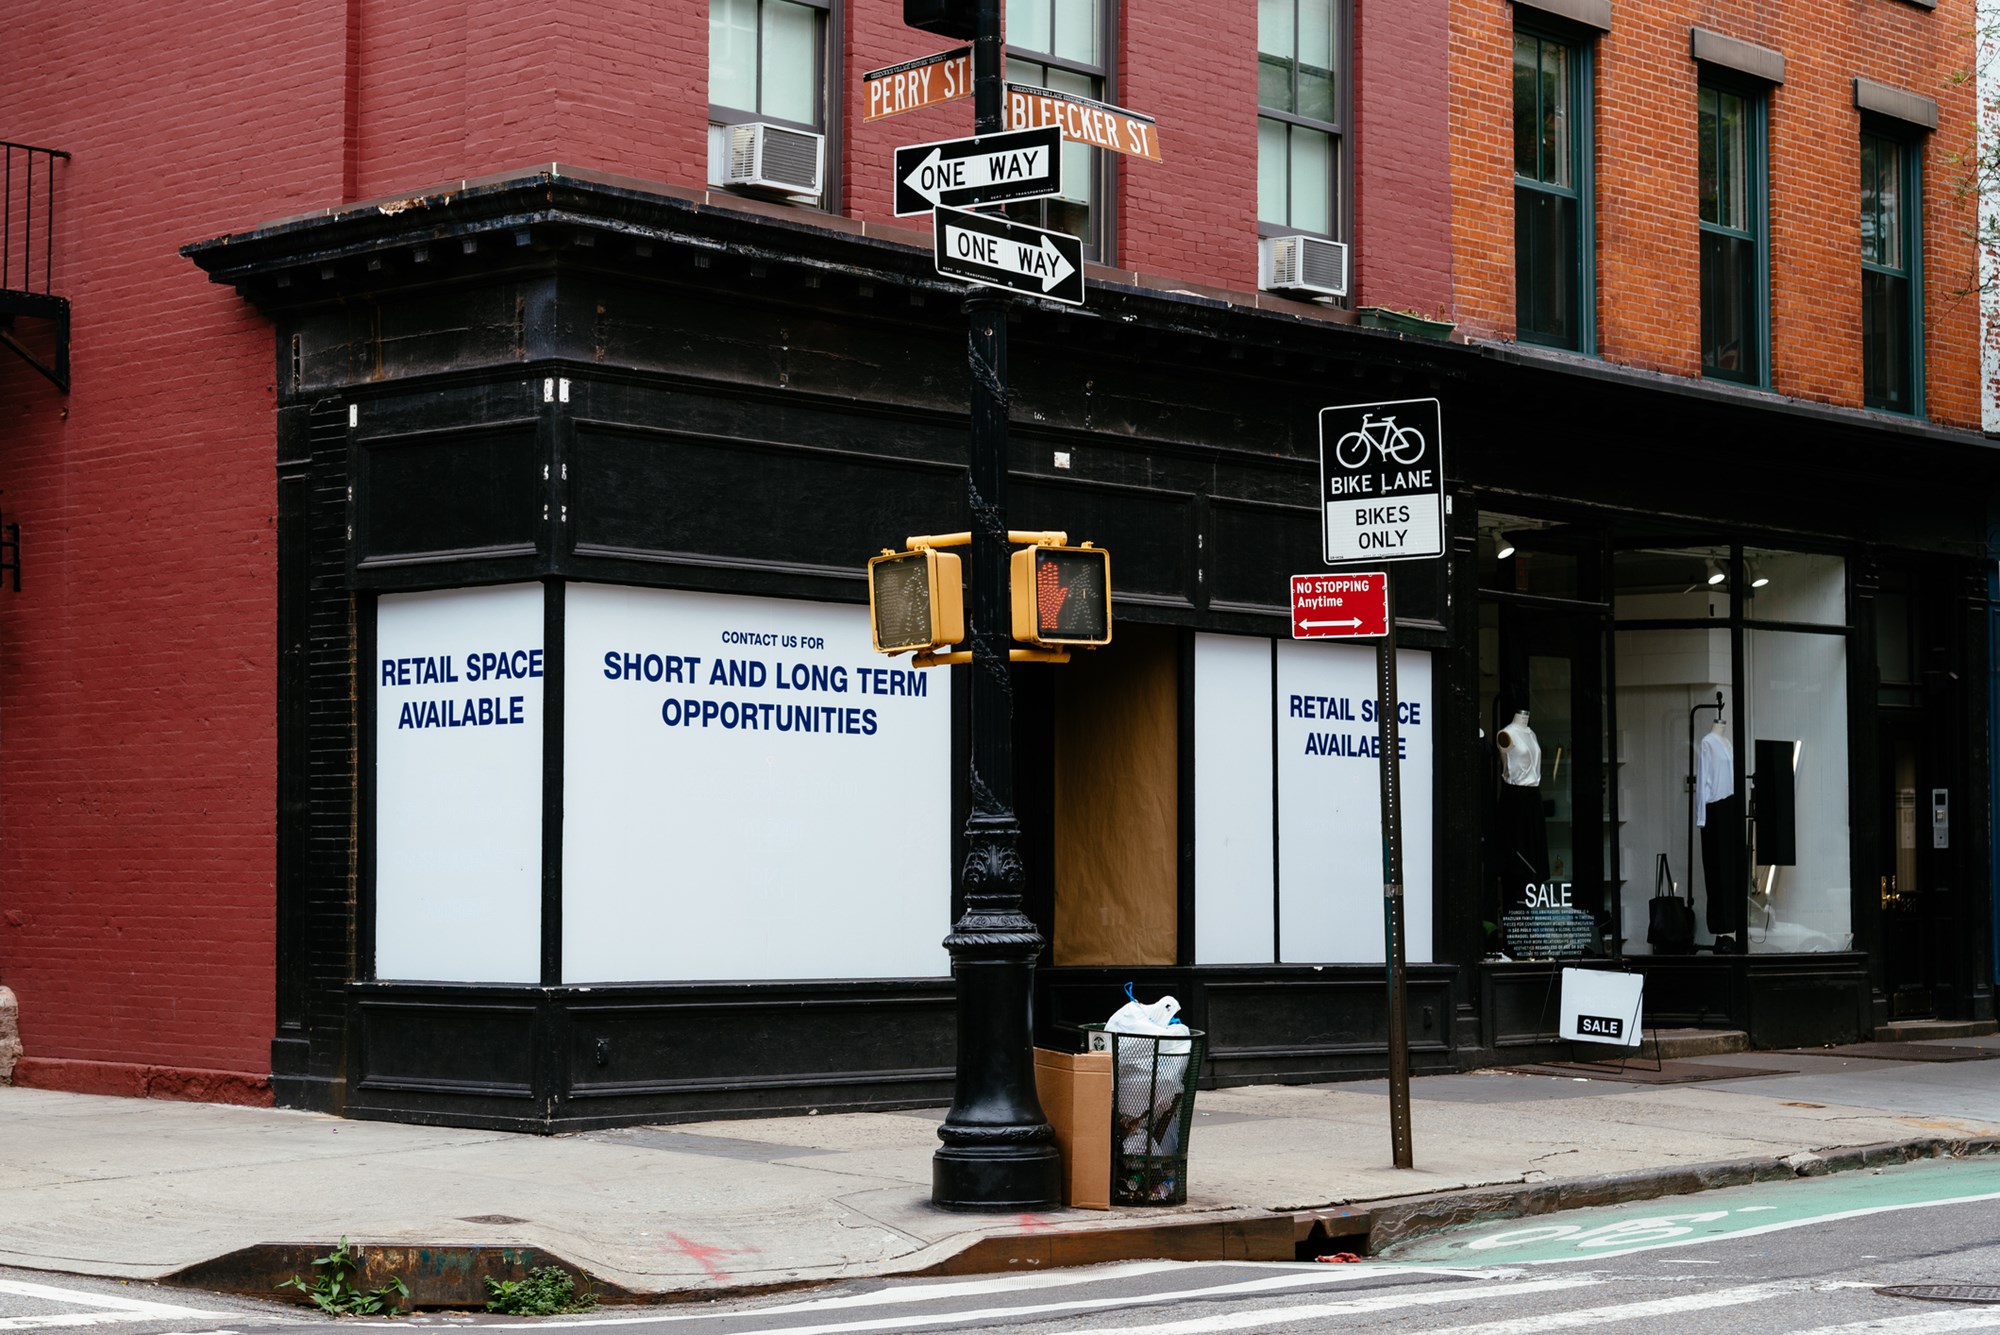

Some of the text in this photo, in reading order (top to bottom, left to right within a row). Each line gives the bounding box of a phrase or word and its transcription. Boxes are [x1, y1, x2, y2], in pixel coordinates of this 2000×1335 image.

[871, 57, 966, 118] PERRY ST
[1012, 93, 1150, 156] BLEECKER ST
[921, 150, 1039, 191] ONE WAY
[1015, 188, 1054, 196] TRANSPORTATION
[957, 232, 1060, 278] ONE WAY
[964, 272, 998, 282] TRANSPORTATION
[1331, 469, 1433, 495] BIKE LANE
[1355, 505, 1410, 526] BIKES
[1358, 529, 1408, 549] ONLY
[1296, 580, 1369, 594] NO STOPPING
[1298, 596, 1343, 608] Anytime
[721, 631, 824, 650] CONTACT US FOR
[381, 649, 543, 686] RETAIL SPACE
[603, 651, 927, 697] SHORT AND LONG TERM
[398, 696, 524, 729] AVAILABLE
[662, 698, 878, 735] OPPORTUNITIES
[1290, 694, 1355, 721] RETAIL
[1304, 732, 1406, 760] AVAILABE
[1525, 883, 1573, 908] SALE
[1583, 1019, 1618, 1034] SALE
